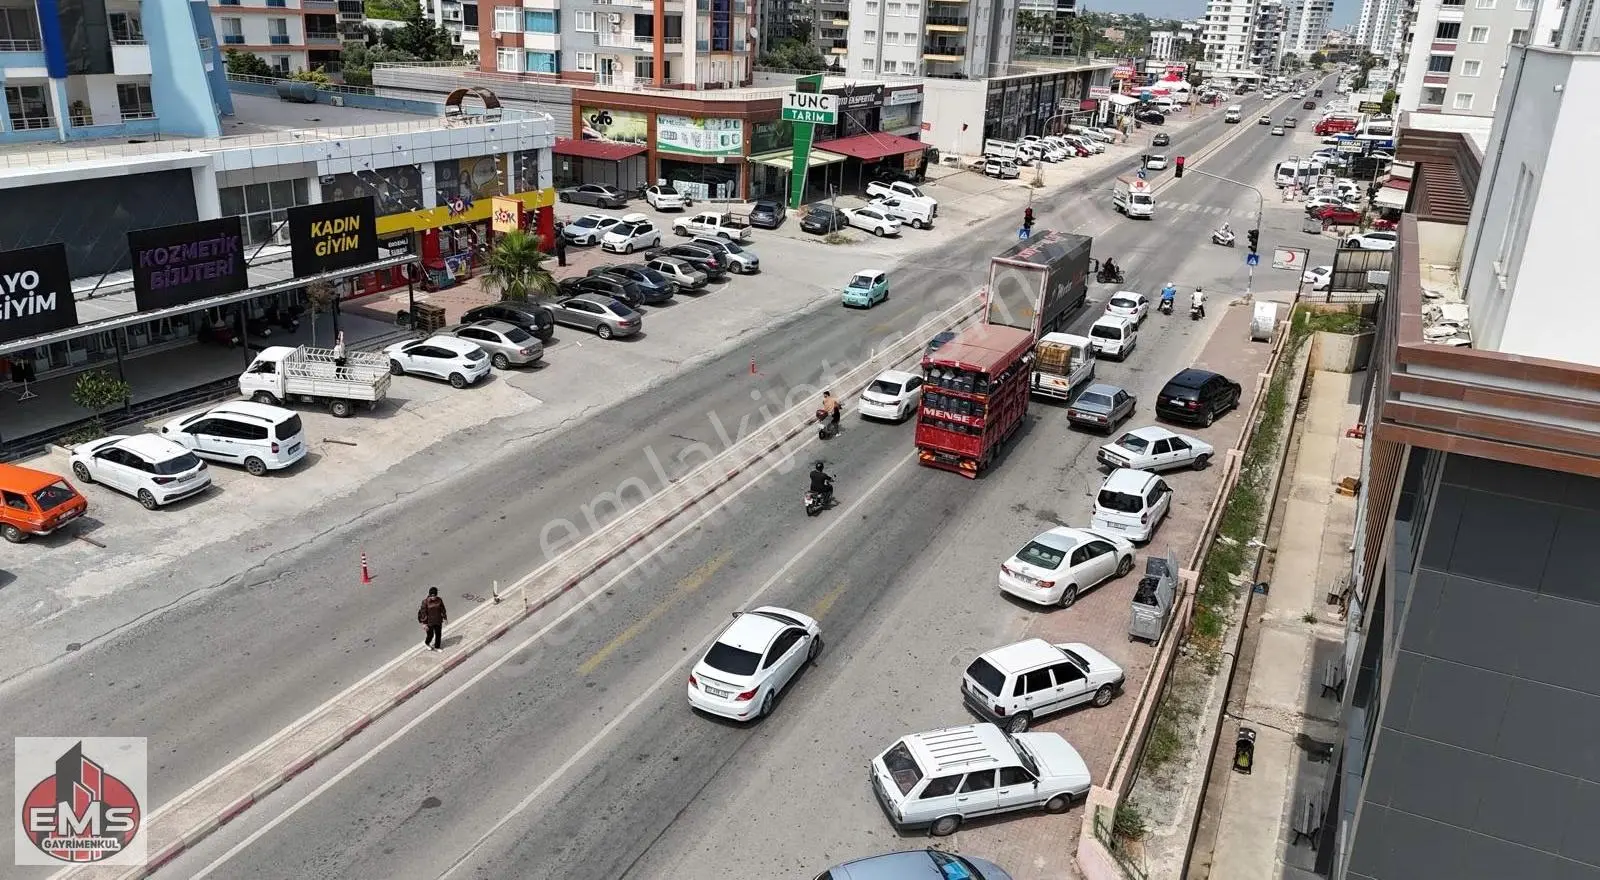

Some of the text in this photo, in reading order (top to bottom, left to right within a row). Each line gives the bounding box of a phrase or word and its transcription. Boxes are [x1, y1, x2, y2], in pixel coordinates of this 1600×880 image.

[792, 110, 825, 122] TARIM
[311, 215, 360, 238] KADIN
[139, 232, 239, 268] KOZMETİK
[315, 233, 359, 256] GİYİM
[0, 270, 40, 295] YO
[150, 252, 234, 291] BİJUTERİ
[0, 290, 57, 320] İYİM
